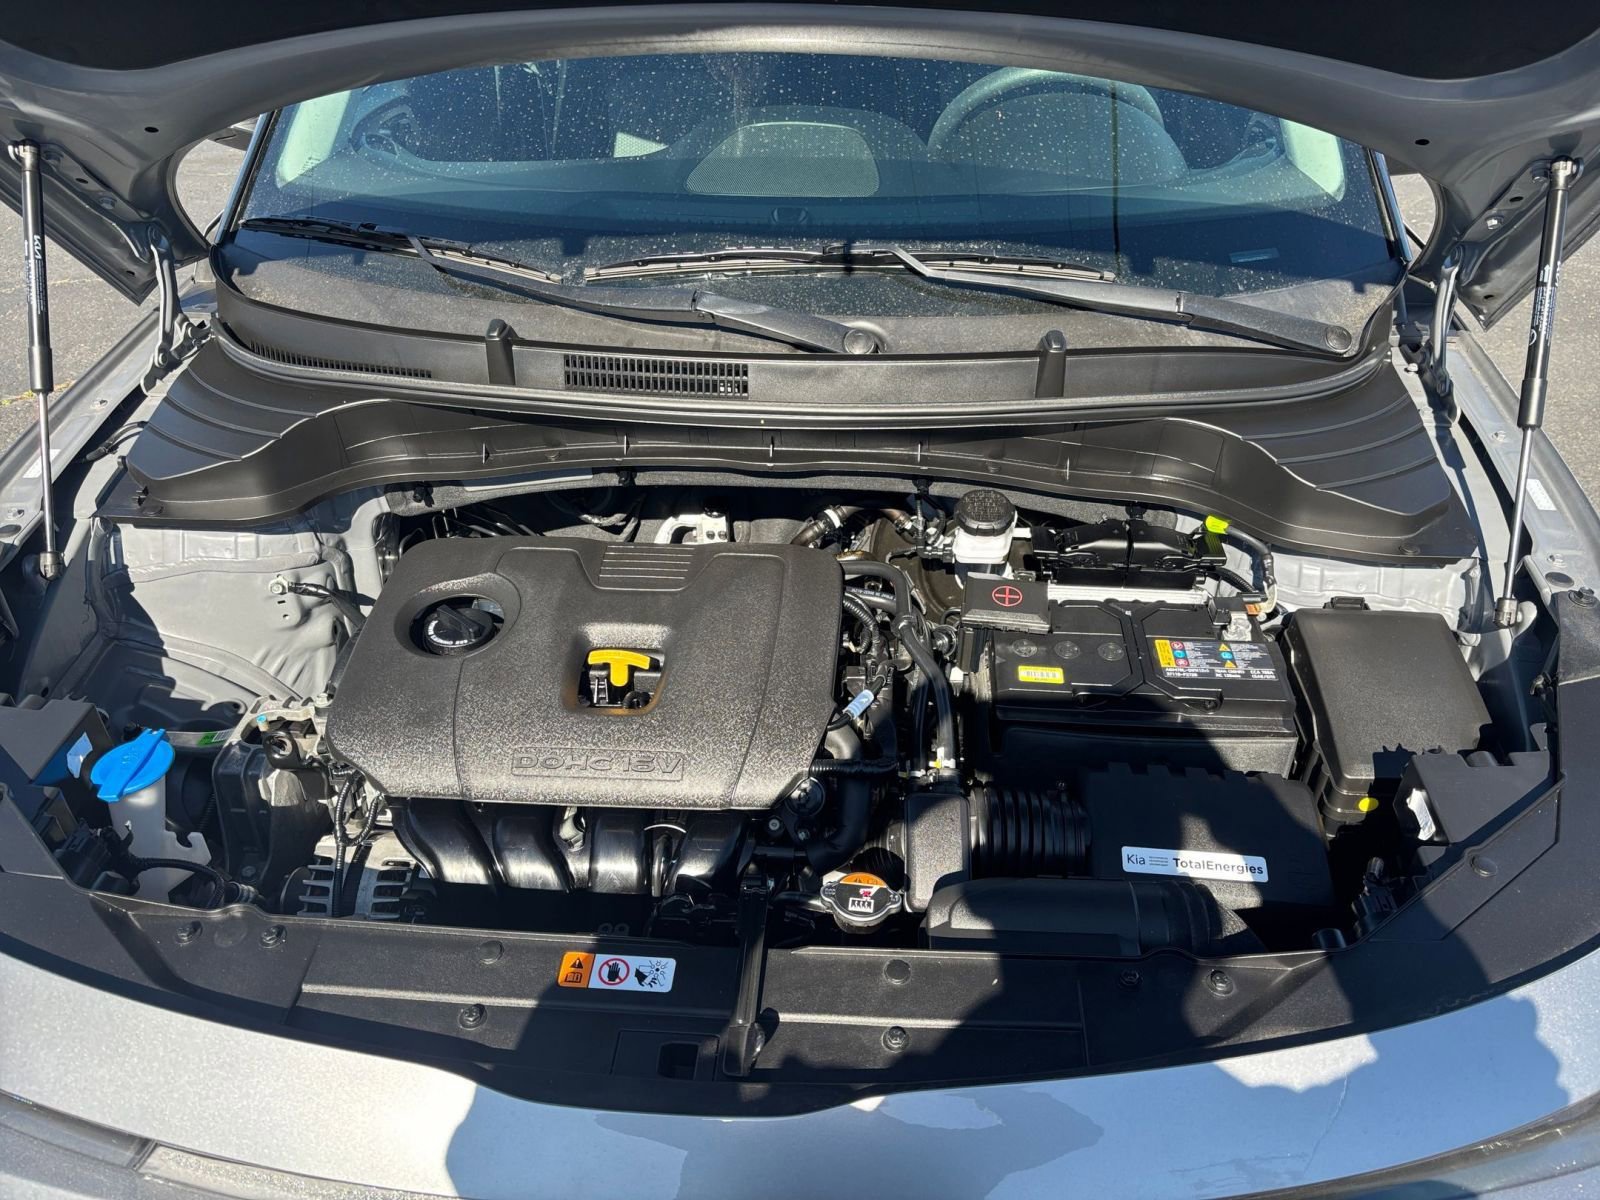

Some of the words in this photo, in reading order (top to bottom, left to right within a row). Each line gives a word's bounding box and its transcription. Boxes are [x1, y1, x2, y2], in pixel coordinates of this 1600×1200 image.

[514, 753, 613, 771] DOHC
[1127, 854, 1146, 865] Kia
[1172, 857, 1264, 875] TotalEnergies
